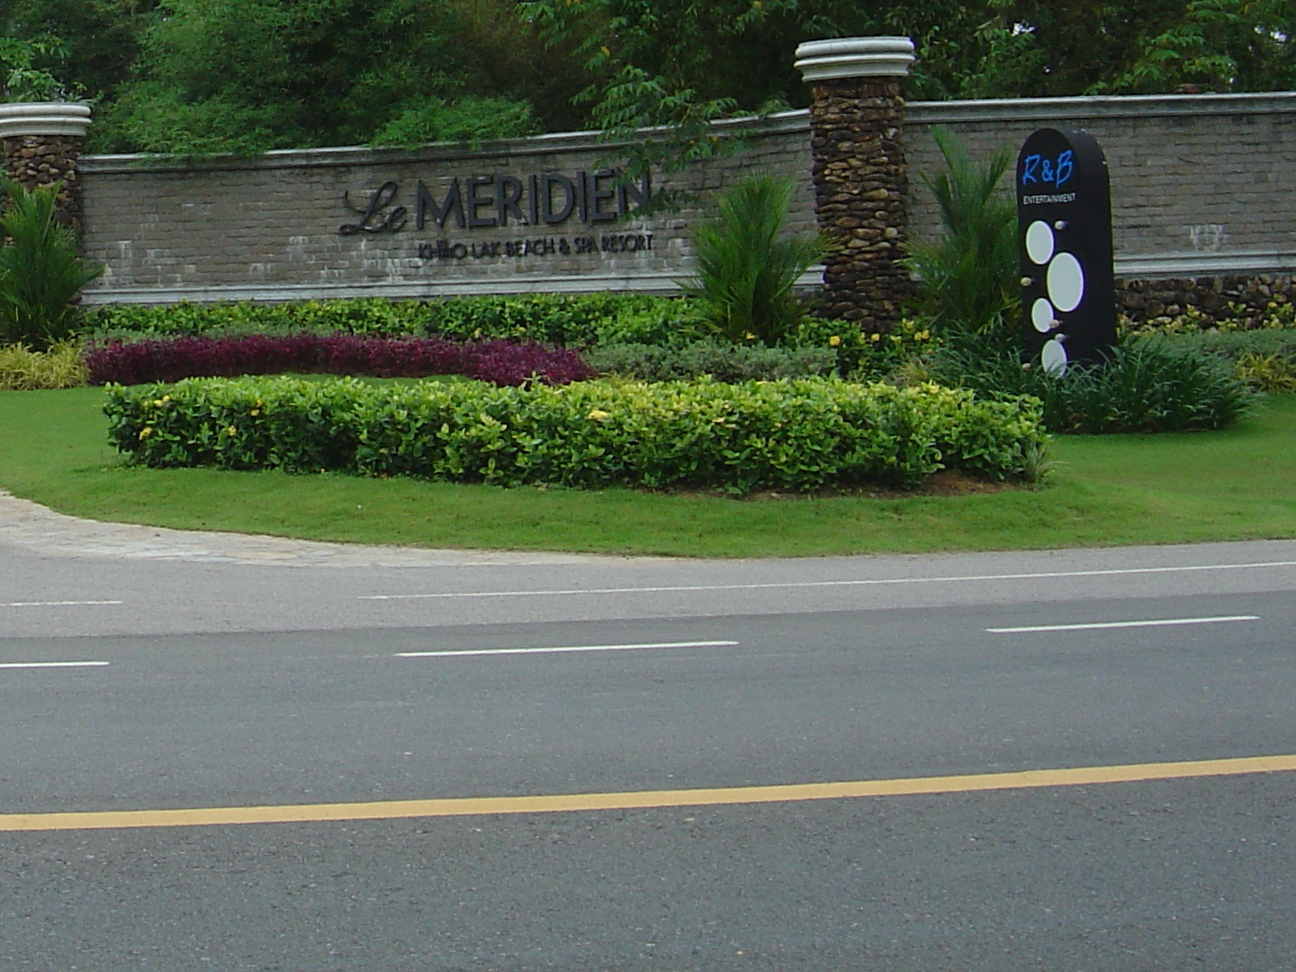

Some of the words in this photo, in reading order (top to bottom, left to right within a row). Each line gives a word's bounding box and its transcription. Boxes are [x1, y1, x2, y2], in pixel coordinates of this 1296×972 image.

[1022, 149, 1073, 189] R&B
[338, 180, 408, 235] Le
[415, 168, 652, 232] MERIDIEN
[1023, 192, 1076, 205] ENTERTAINMENT
[471, 241, 502, 258] LAK
[505, 238, 555, 256] BEACH
[559, 237, 570, 254] &
[574, 236, 599, 254] SPA
[601, 233, 653, 252] RESORT
